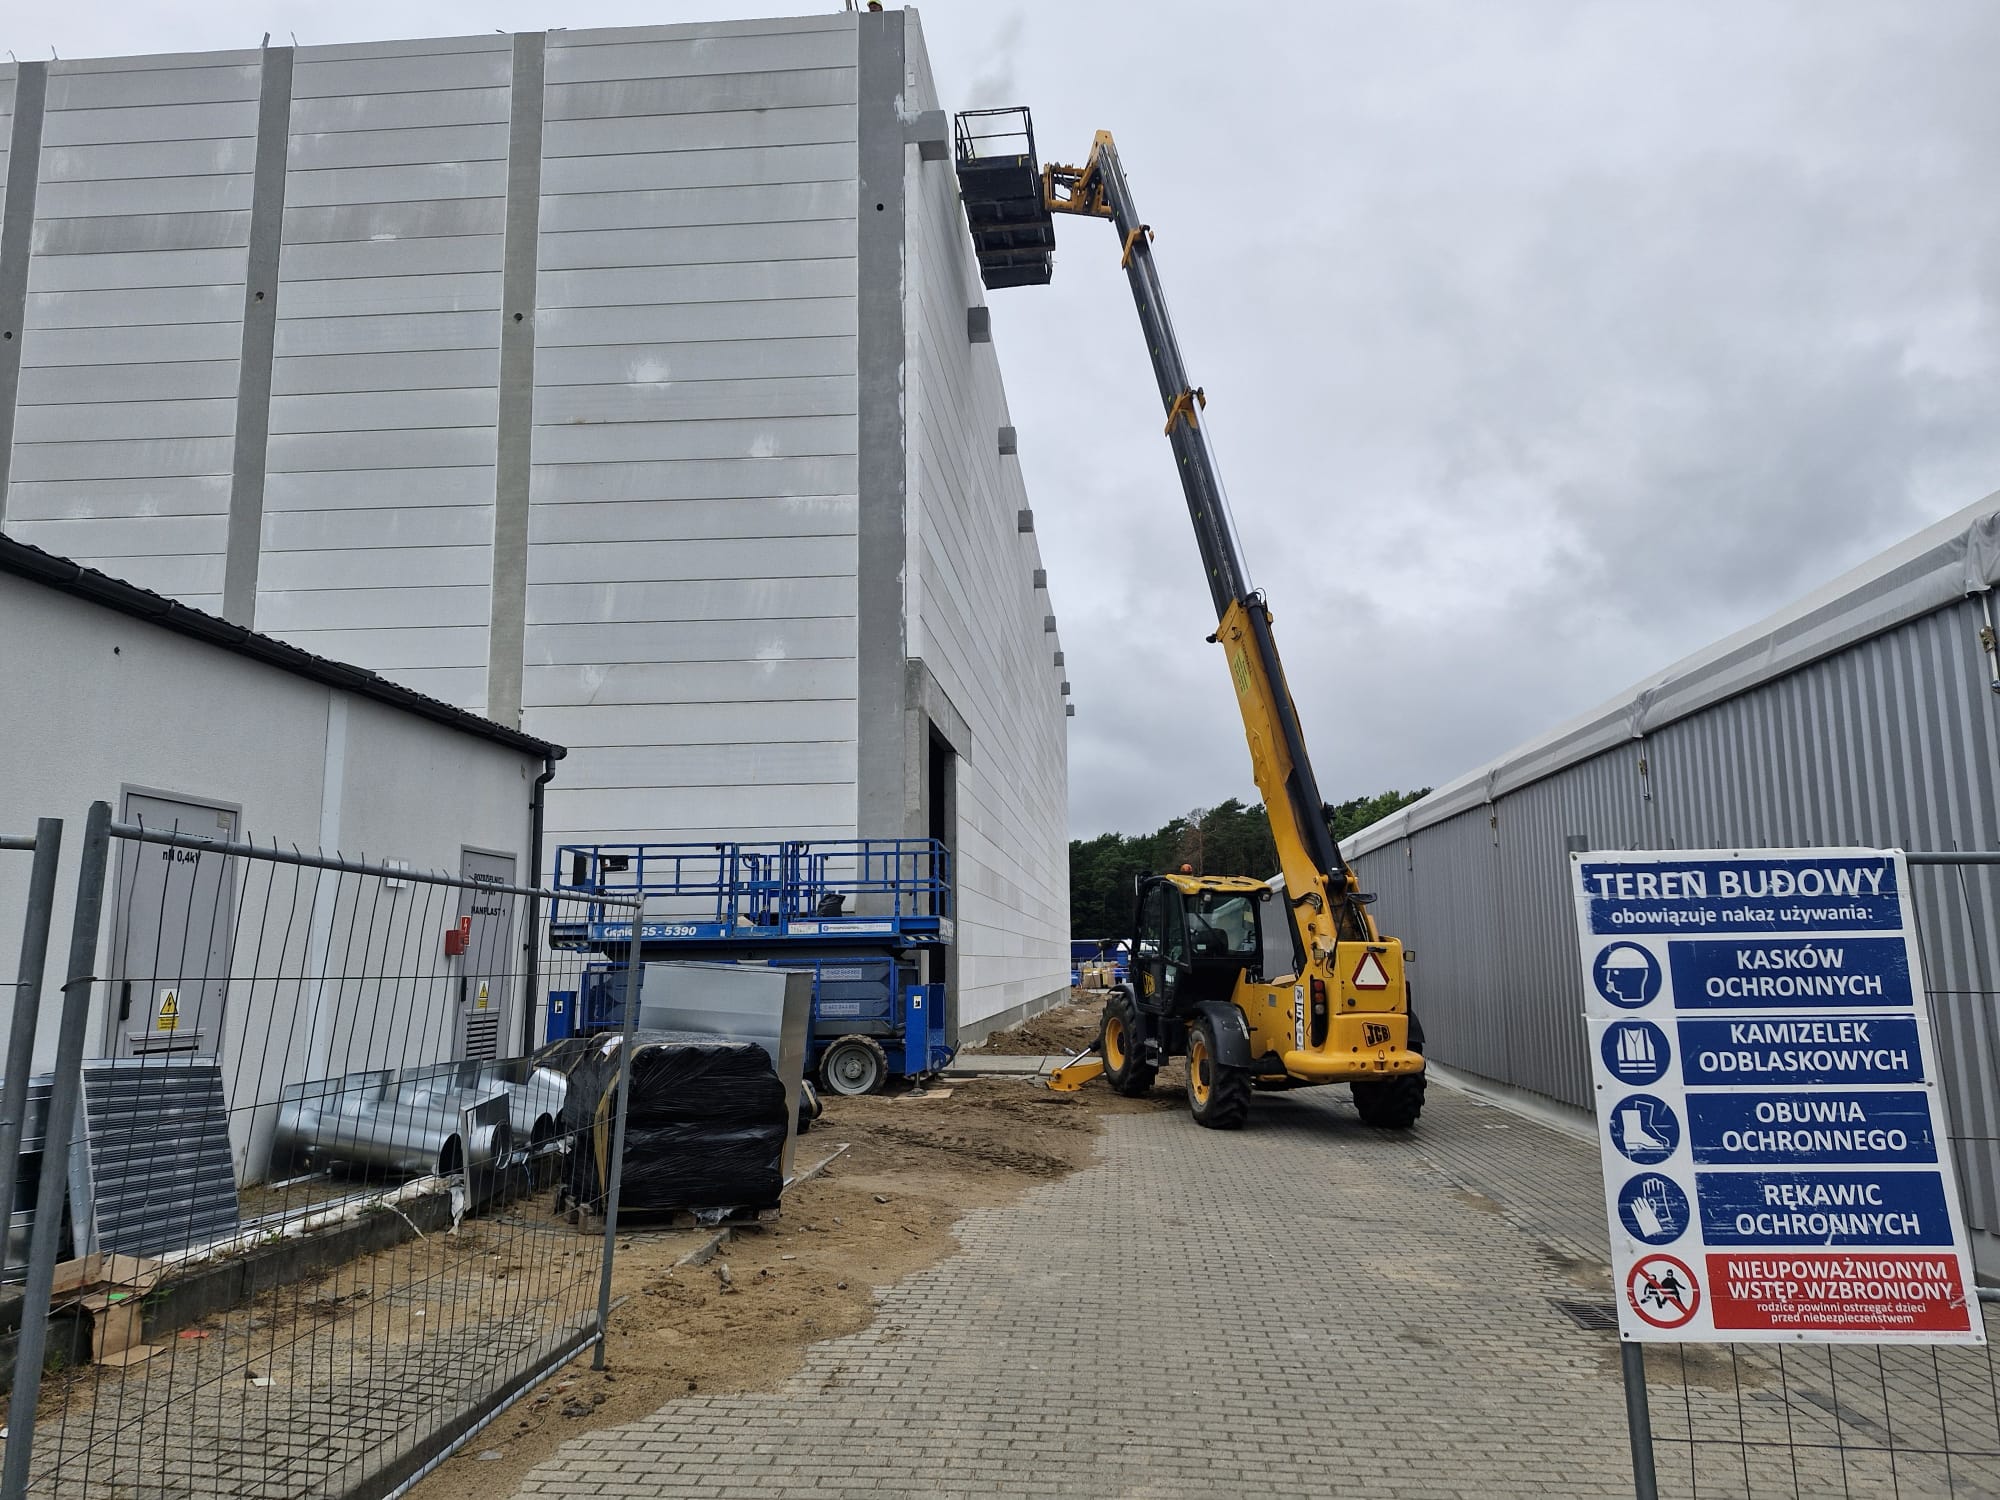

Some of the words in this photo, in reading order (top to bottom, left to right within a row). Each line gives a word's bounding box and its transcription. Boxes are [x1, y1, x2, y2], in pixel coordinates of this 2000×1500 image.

[1592, 870, 1708, 900] TEREN
[1718, 867, 1884, 898] BUDOWY
[1611, 907, 1717, 927] obowiązuje
[1722, 905, 1775, 922] nakaz
[1780, 903, 1874, 924] używania:
[1735, 943, 1844, 970] KASKÓW
[1705, 974, 1883, 998] OCHRONNYCH
[1365, 1023, 1390, 1045] JCB
[1730, 1022, 1871, 1045] KAMIZELEK
[1699, 1049, 1910, 1073] ODBLASKOWYCH
[1755, 1101, 1867, 1124] OBUWIA
[1722, 1129, 1908, 1152] OCHRONNEGO
[1763, 1183, 1884, 1211] RĘKAWIC
[1735, 1213, 1922, 1236] OCHRONNYCH
[1727, 1257, 1948, 1280] NIEUPOWAŻNIONYM
[1728, 1281, 1798, 1303] WSTĘP
[1803, 1281, 1953, 1300] WZBRONIONY
[1757, 1303, 1795, 1312] rodzice
[1797, 1303, 1841, 1314] powinni
[1843, 1301, 1893, 1314] ostrzegać
[1895, 1302, 1927, 1312] dzieci
[1771, 1313, 1801, 1324] przed
[1803, 1312, 1914, 1325] niebezpieczeństwem
